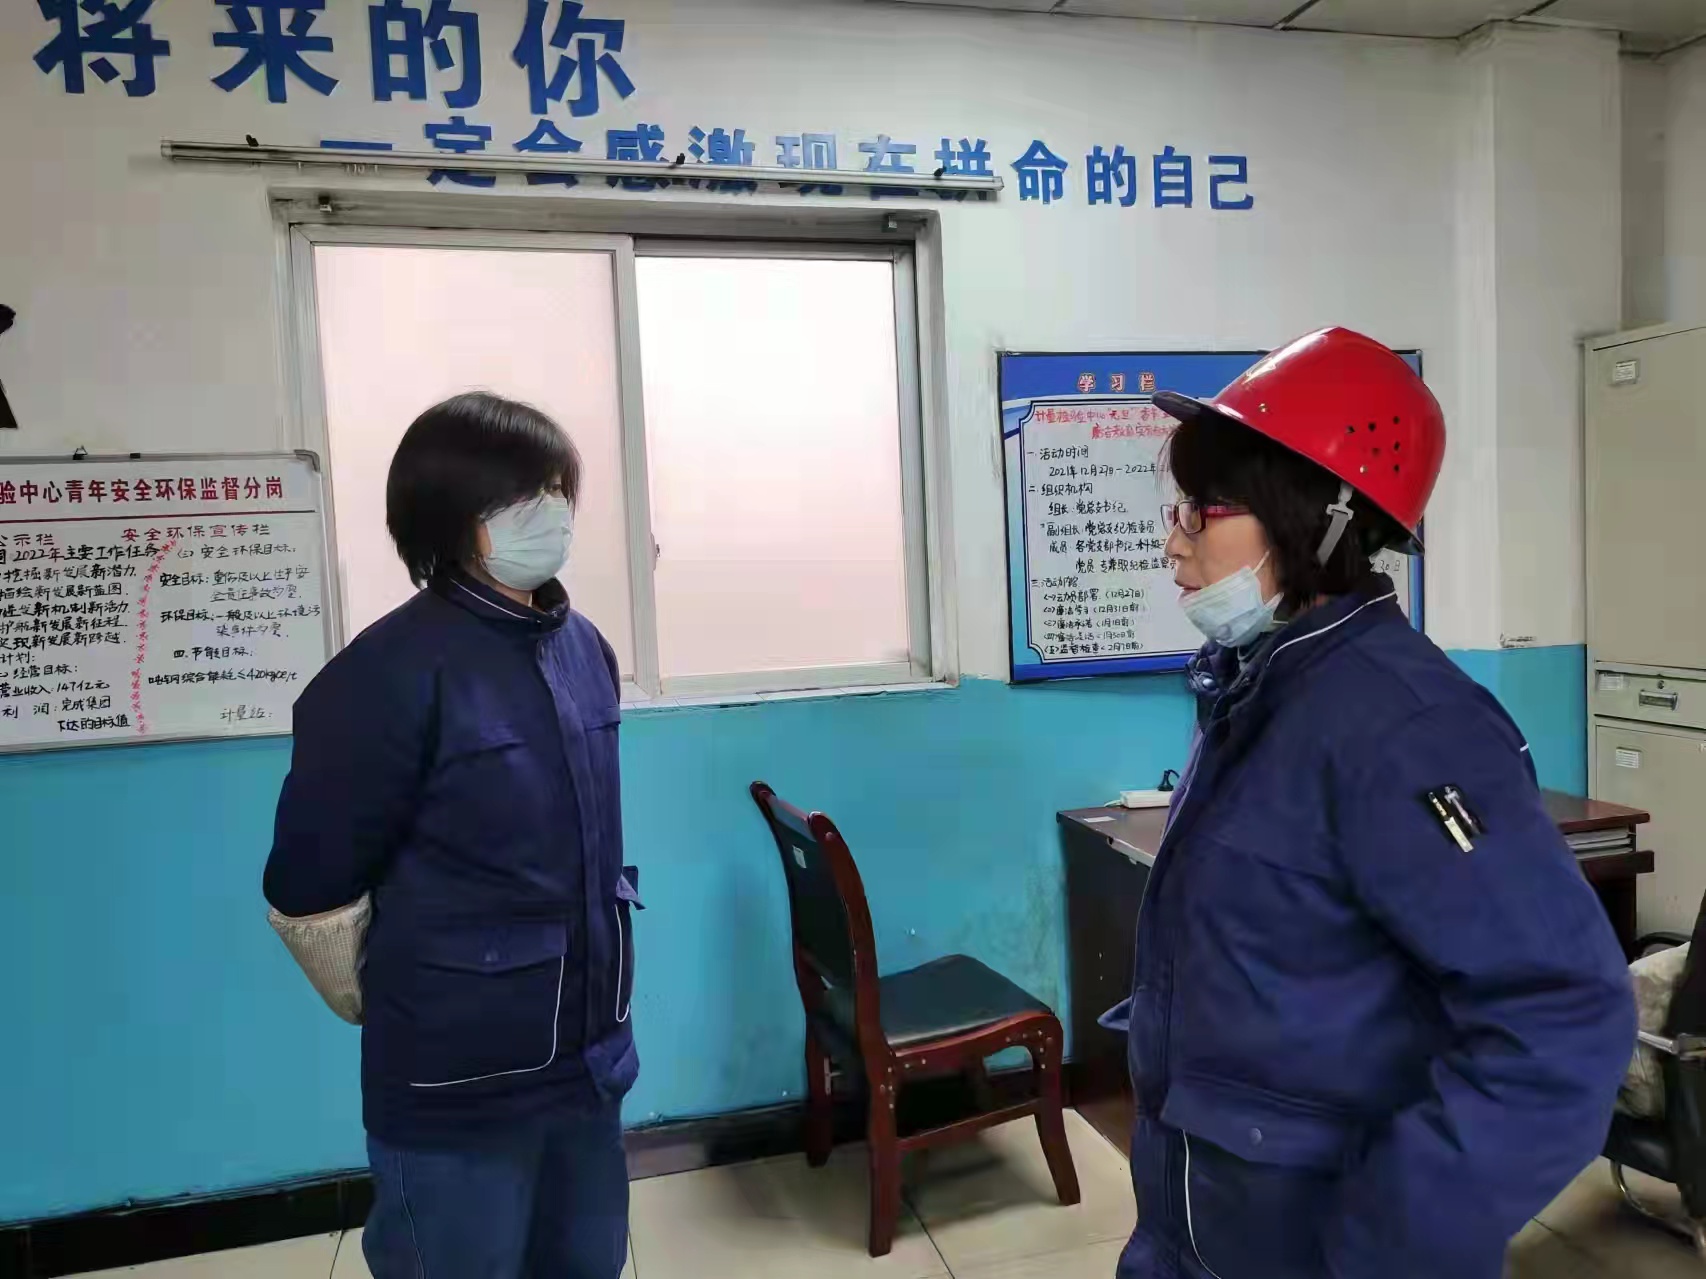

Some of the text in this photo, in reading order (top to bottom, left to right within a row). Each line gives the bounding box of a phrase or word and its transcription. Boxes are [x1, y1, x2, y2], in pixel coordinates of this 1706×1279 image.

[33, 0, 636, 117] 将来的你
[320, 116, 1254, 210] 一定会感激现在拼命的自己
[1078, 372, 1156, 393] 学习栏
[0, 476, 284, 505] 验中心青年安全环保监督分岗
[121, 523, 271, 543] 安全环保宣传栏
[57, 714, 131, 733] 下达的目标值
